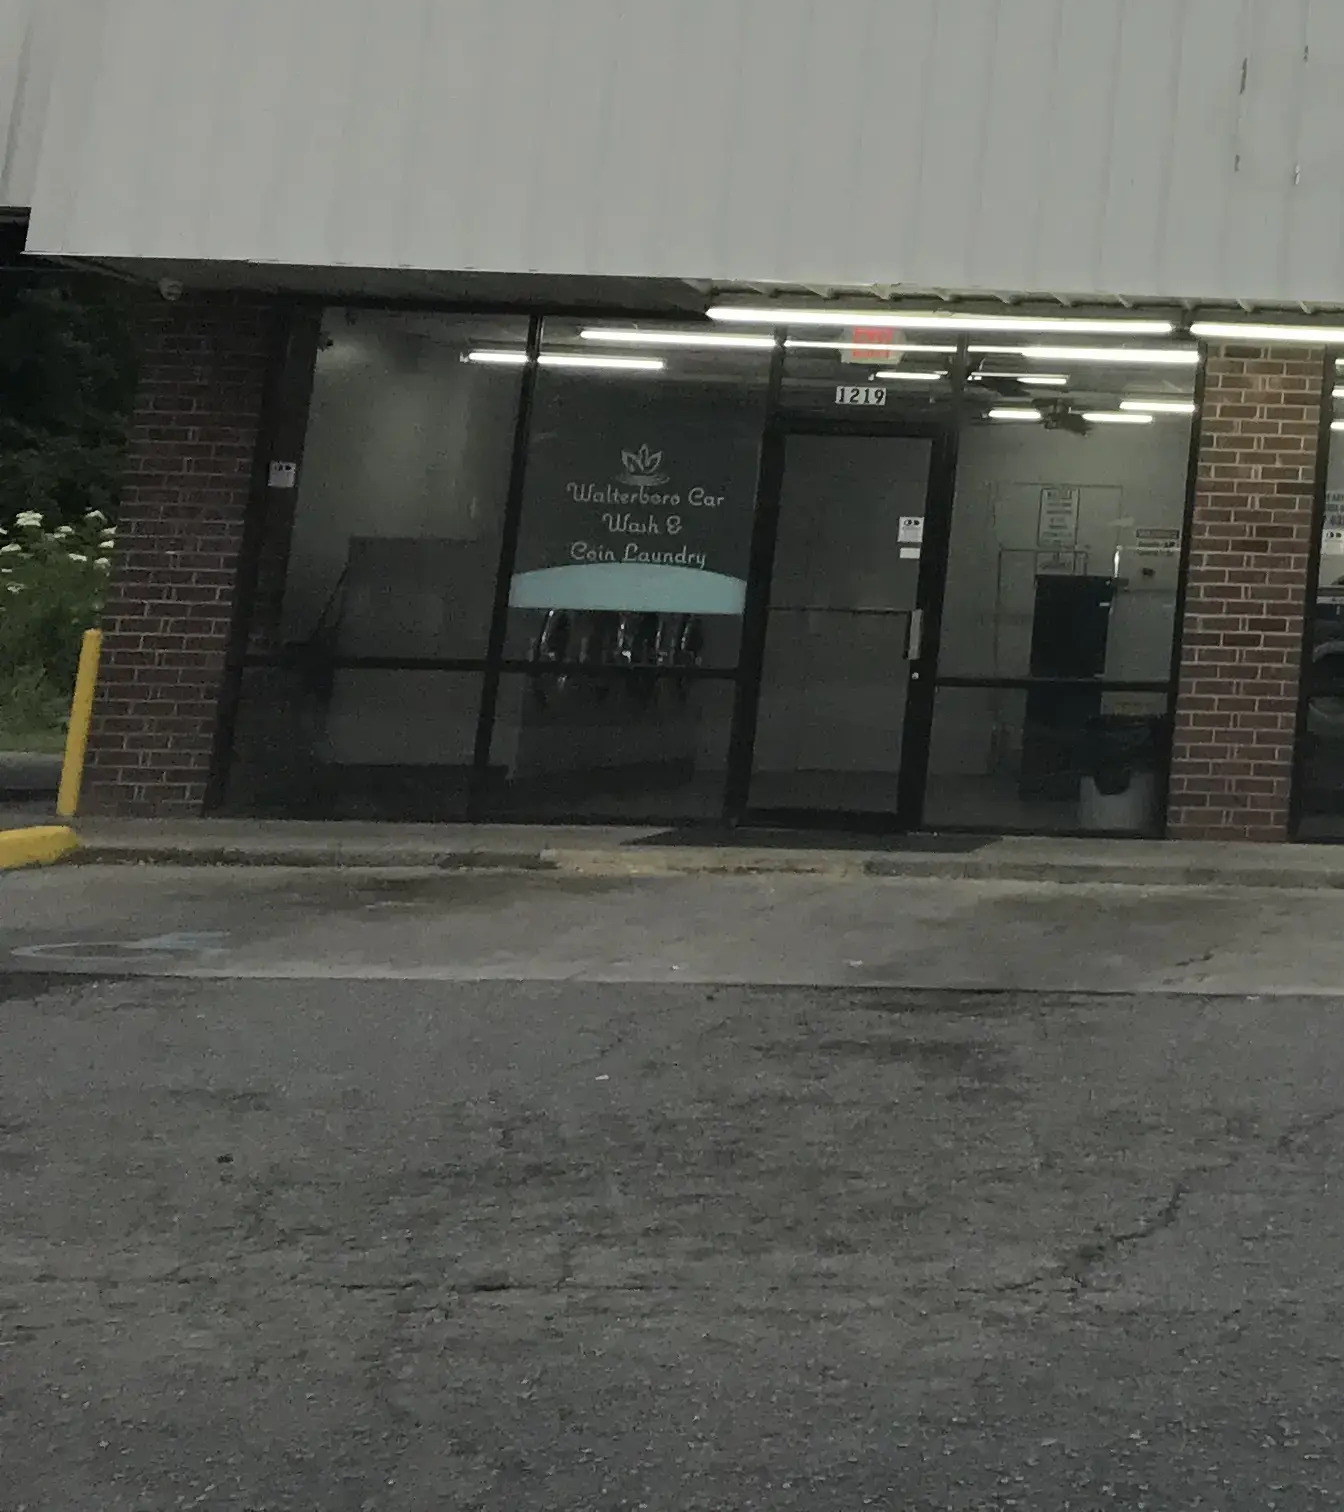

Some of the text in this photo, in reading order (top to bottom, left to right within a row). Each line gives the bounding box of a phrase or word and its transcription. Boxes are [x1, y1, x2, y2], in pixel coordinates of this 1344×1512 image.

[838, 388, 885, 404] 1219
[567, 482, 725, 508] Walterboro Car
[602, 513, 683, 535] Wash &
[570, 541, 706, 568] Coin Laundry
